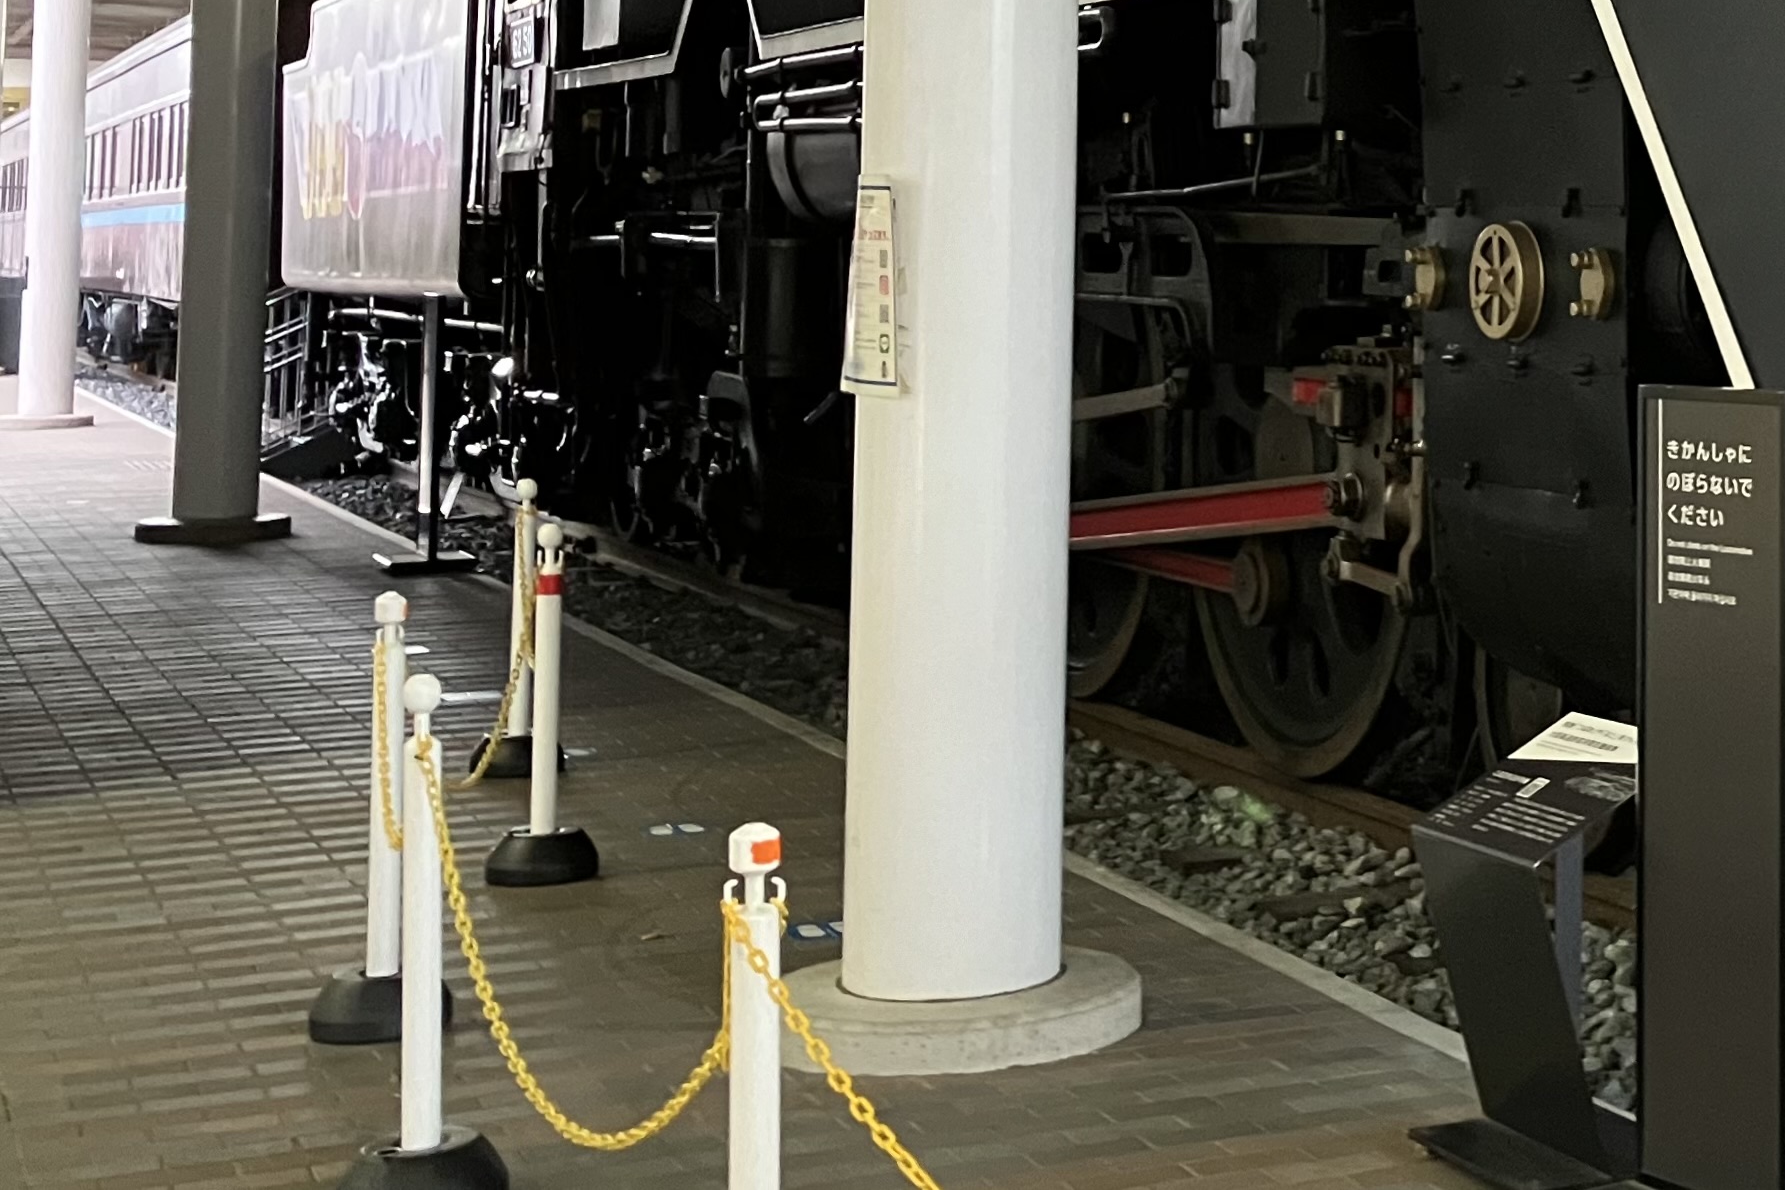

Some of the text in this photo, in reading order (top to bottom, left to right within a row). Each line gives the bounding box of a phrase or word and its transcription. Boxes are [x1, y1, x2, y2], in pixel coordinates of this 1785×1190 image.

[1666, 440, 1752, 463] きかんしゃに
[1666, 472, 1752, 497] のぼらないで
[1667, 504, 1724, 527] ください
